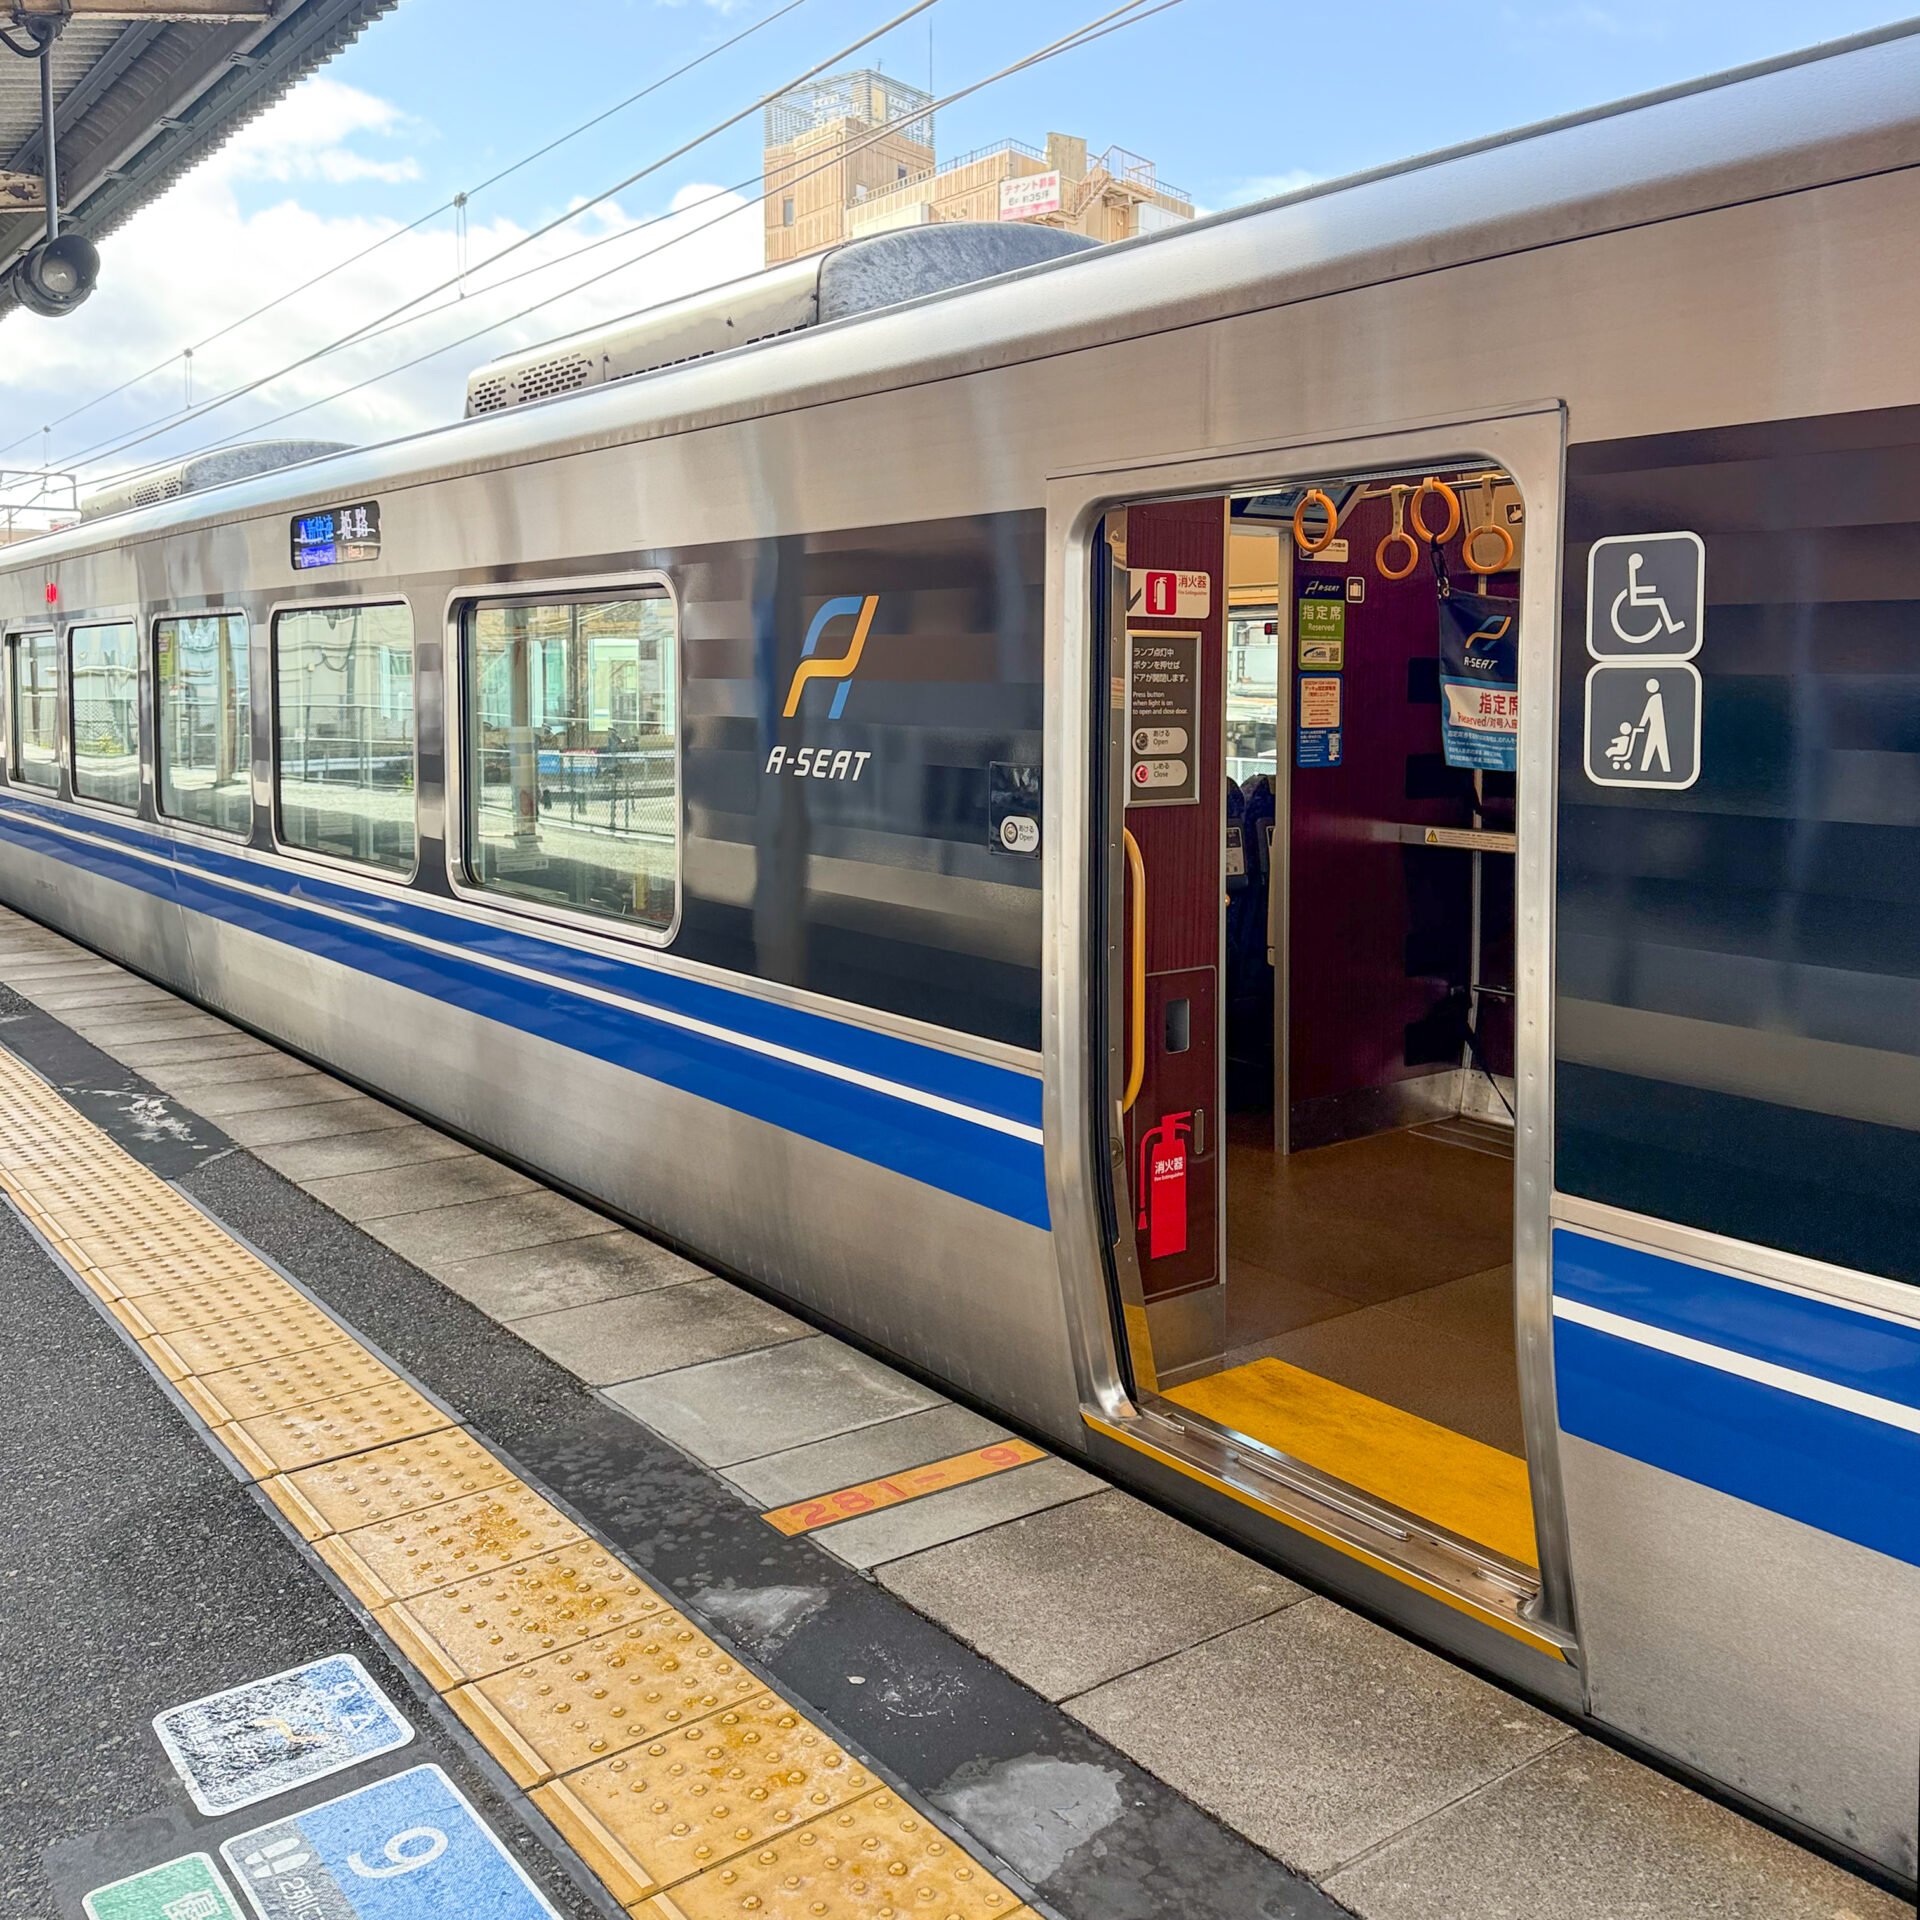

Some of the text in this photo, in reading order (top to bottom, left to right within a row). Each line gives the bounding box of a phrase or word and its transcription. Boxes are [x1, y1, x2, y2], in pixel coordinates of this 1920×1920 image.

[1178, 575, 1207, 589] 消火器
[1302, 604, 1341, 620] 指定席
[1308, 622, 1335, 631] Reserved
[1133, 647, 1174, 657] ランプ点灯中
[1133, 660, 1180, 670] ボタンを押せば
[1463, 656, 1498, 670] A-SEAT
[1147, 690, 1165, 698] button
[1153, 729, 1170, 737] あける
[1153, 738, 1168, 746] Open
[765, 745, 871, 782] A-SEAT
[1018, 824, 1034, 832] あける
[1019, 833, 1034, 841] Open
[1154, 1156, 1183, 1175] 消火器
[346, 1826, 449, 1878] 9
